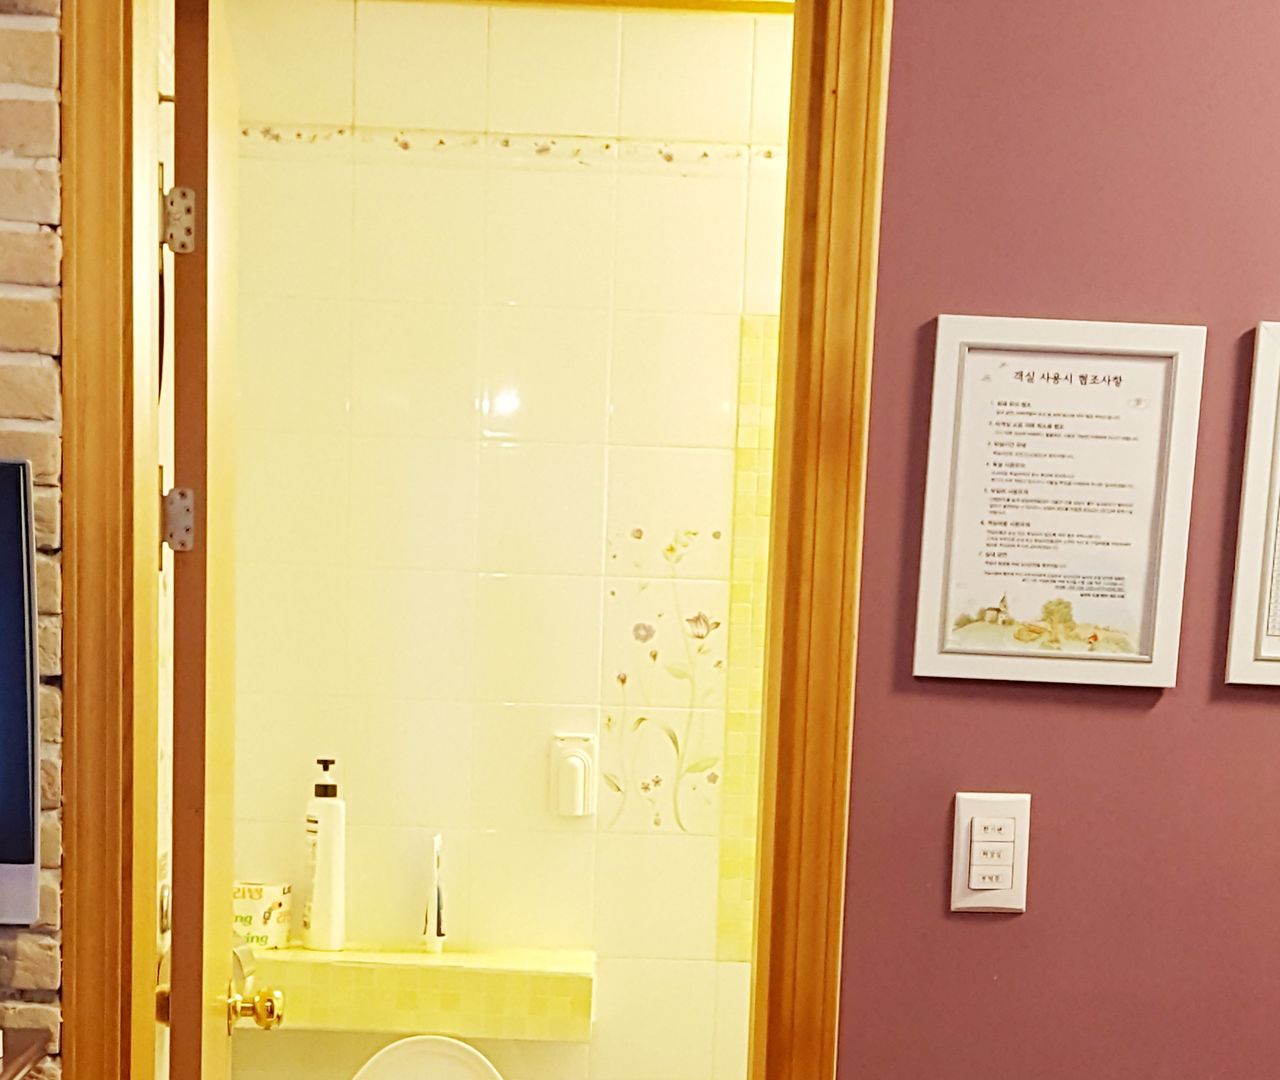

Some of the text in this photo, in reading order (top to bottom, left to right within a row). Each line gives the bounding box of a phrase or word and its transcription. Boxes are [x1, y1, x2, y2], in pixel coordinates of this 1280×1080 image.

[1014, 371, 1123, 387] 객실 사용시 협조사항
